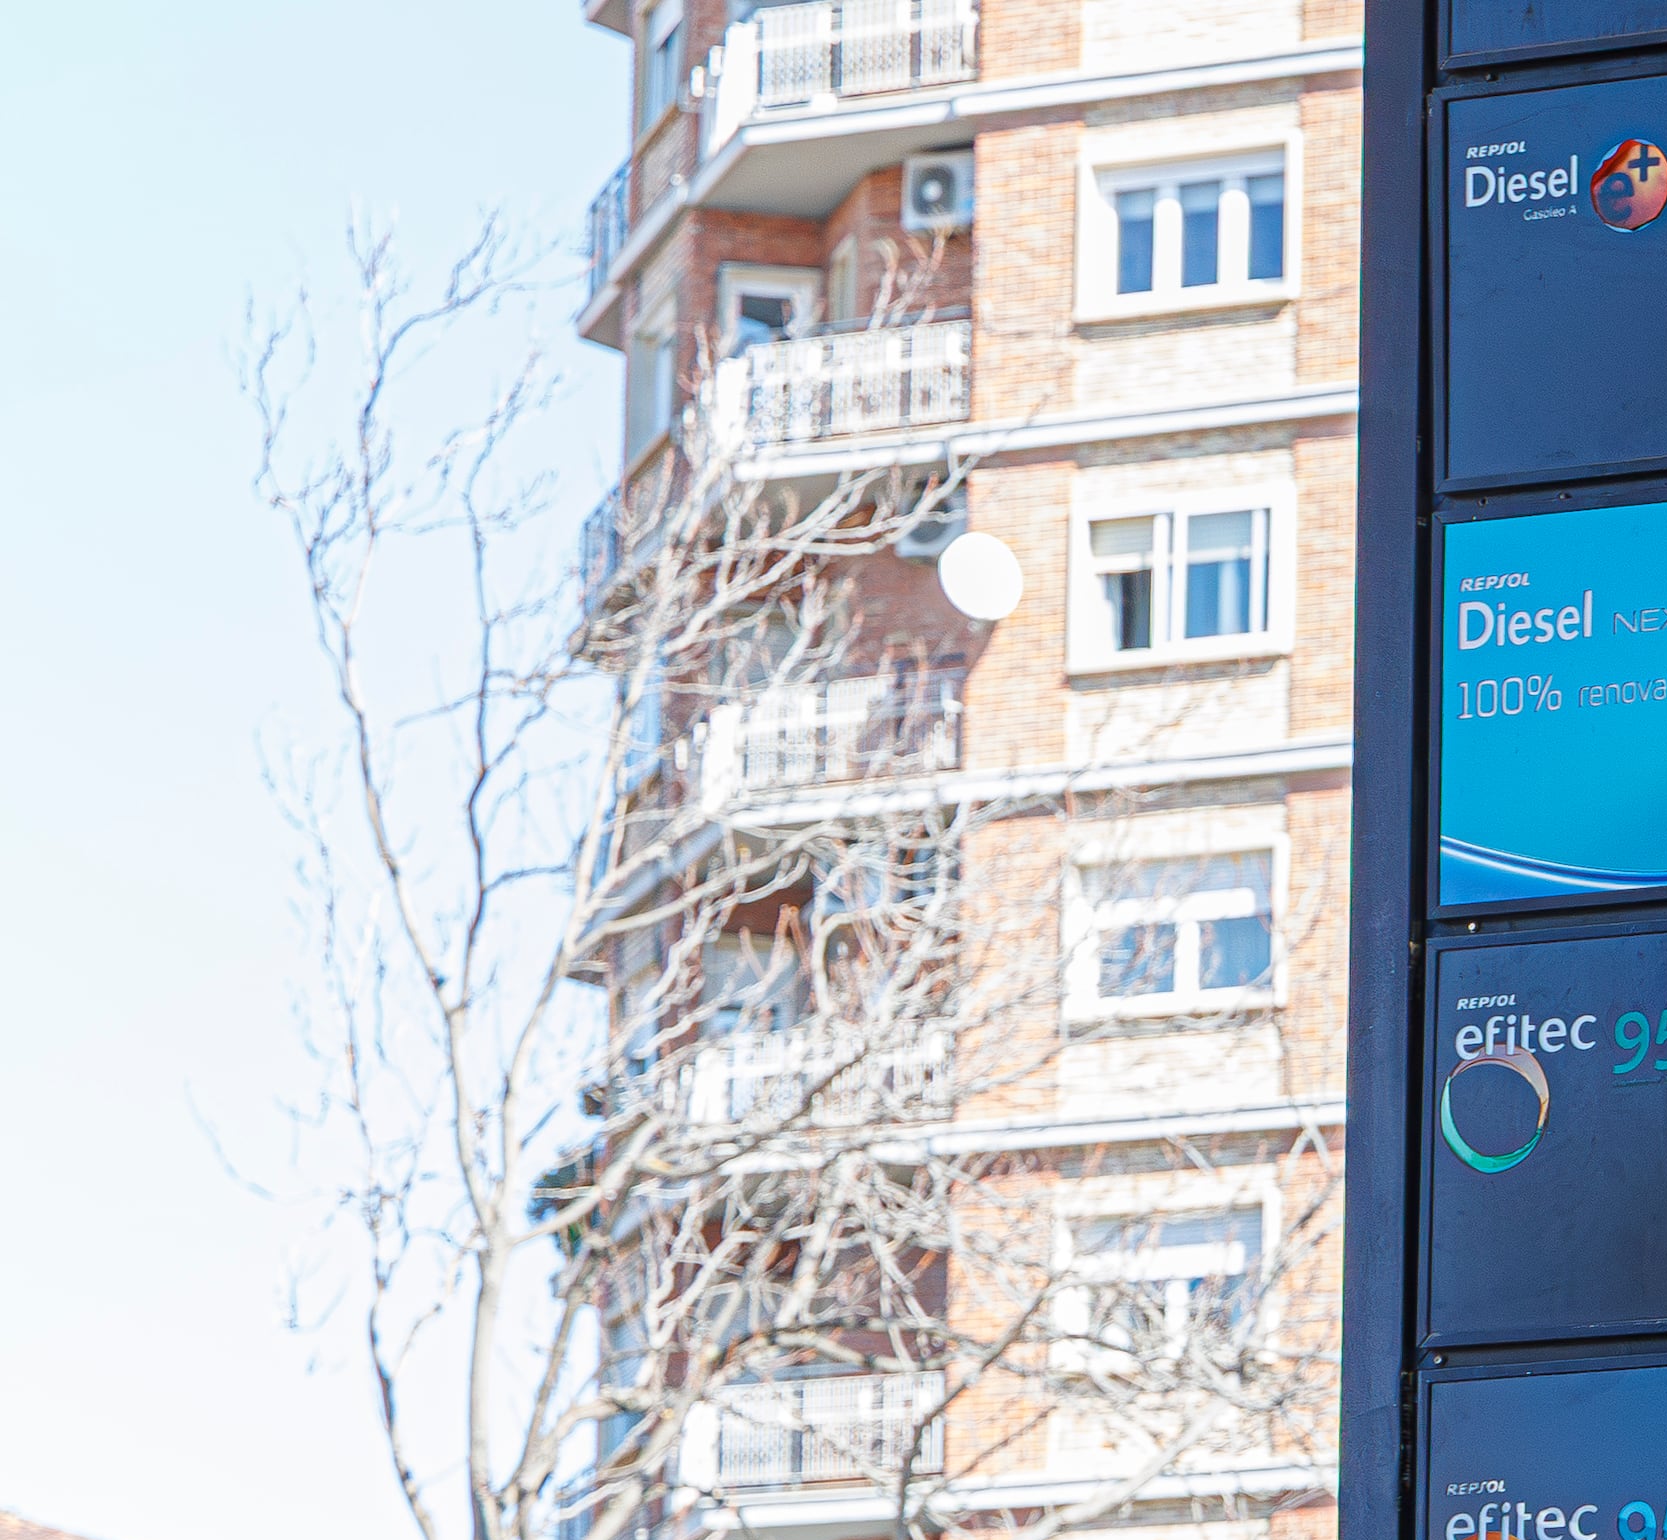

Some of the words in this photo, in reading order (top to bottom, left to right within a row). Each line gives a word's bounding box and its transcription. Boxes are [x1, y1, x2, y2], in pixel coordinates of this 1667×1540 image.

[1466, 141, 1527, 159] REPSOL
[1465, 154, 1578, 208] Diesel
[1460, 573, 1530, 592] REPSOL
[1458, 589, 1593, 650] Diesel
[1457, 674, 1562, 719] 100%
[1456, 993, 1517, 1010] REPSOL
[1455, 1013, 1598, 1061] efitec
[1446, 1479, 1506, 1496] REPSOL
